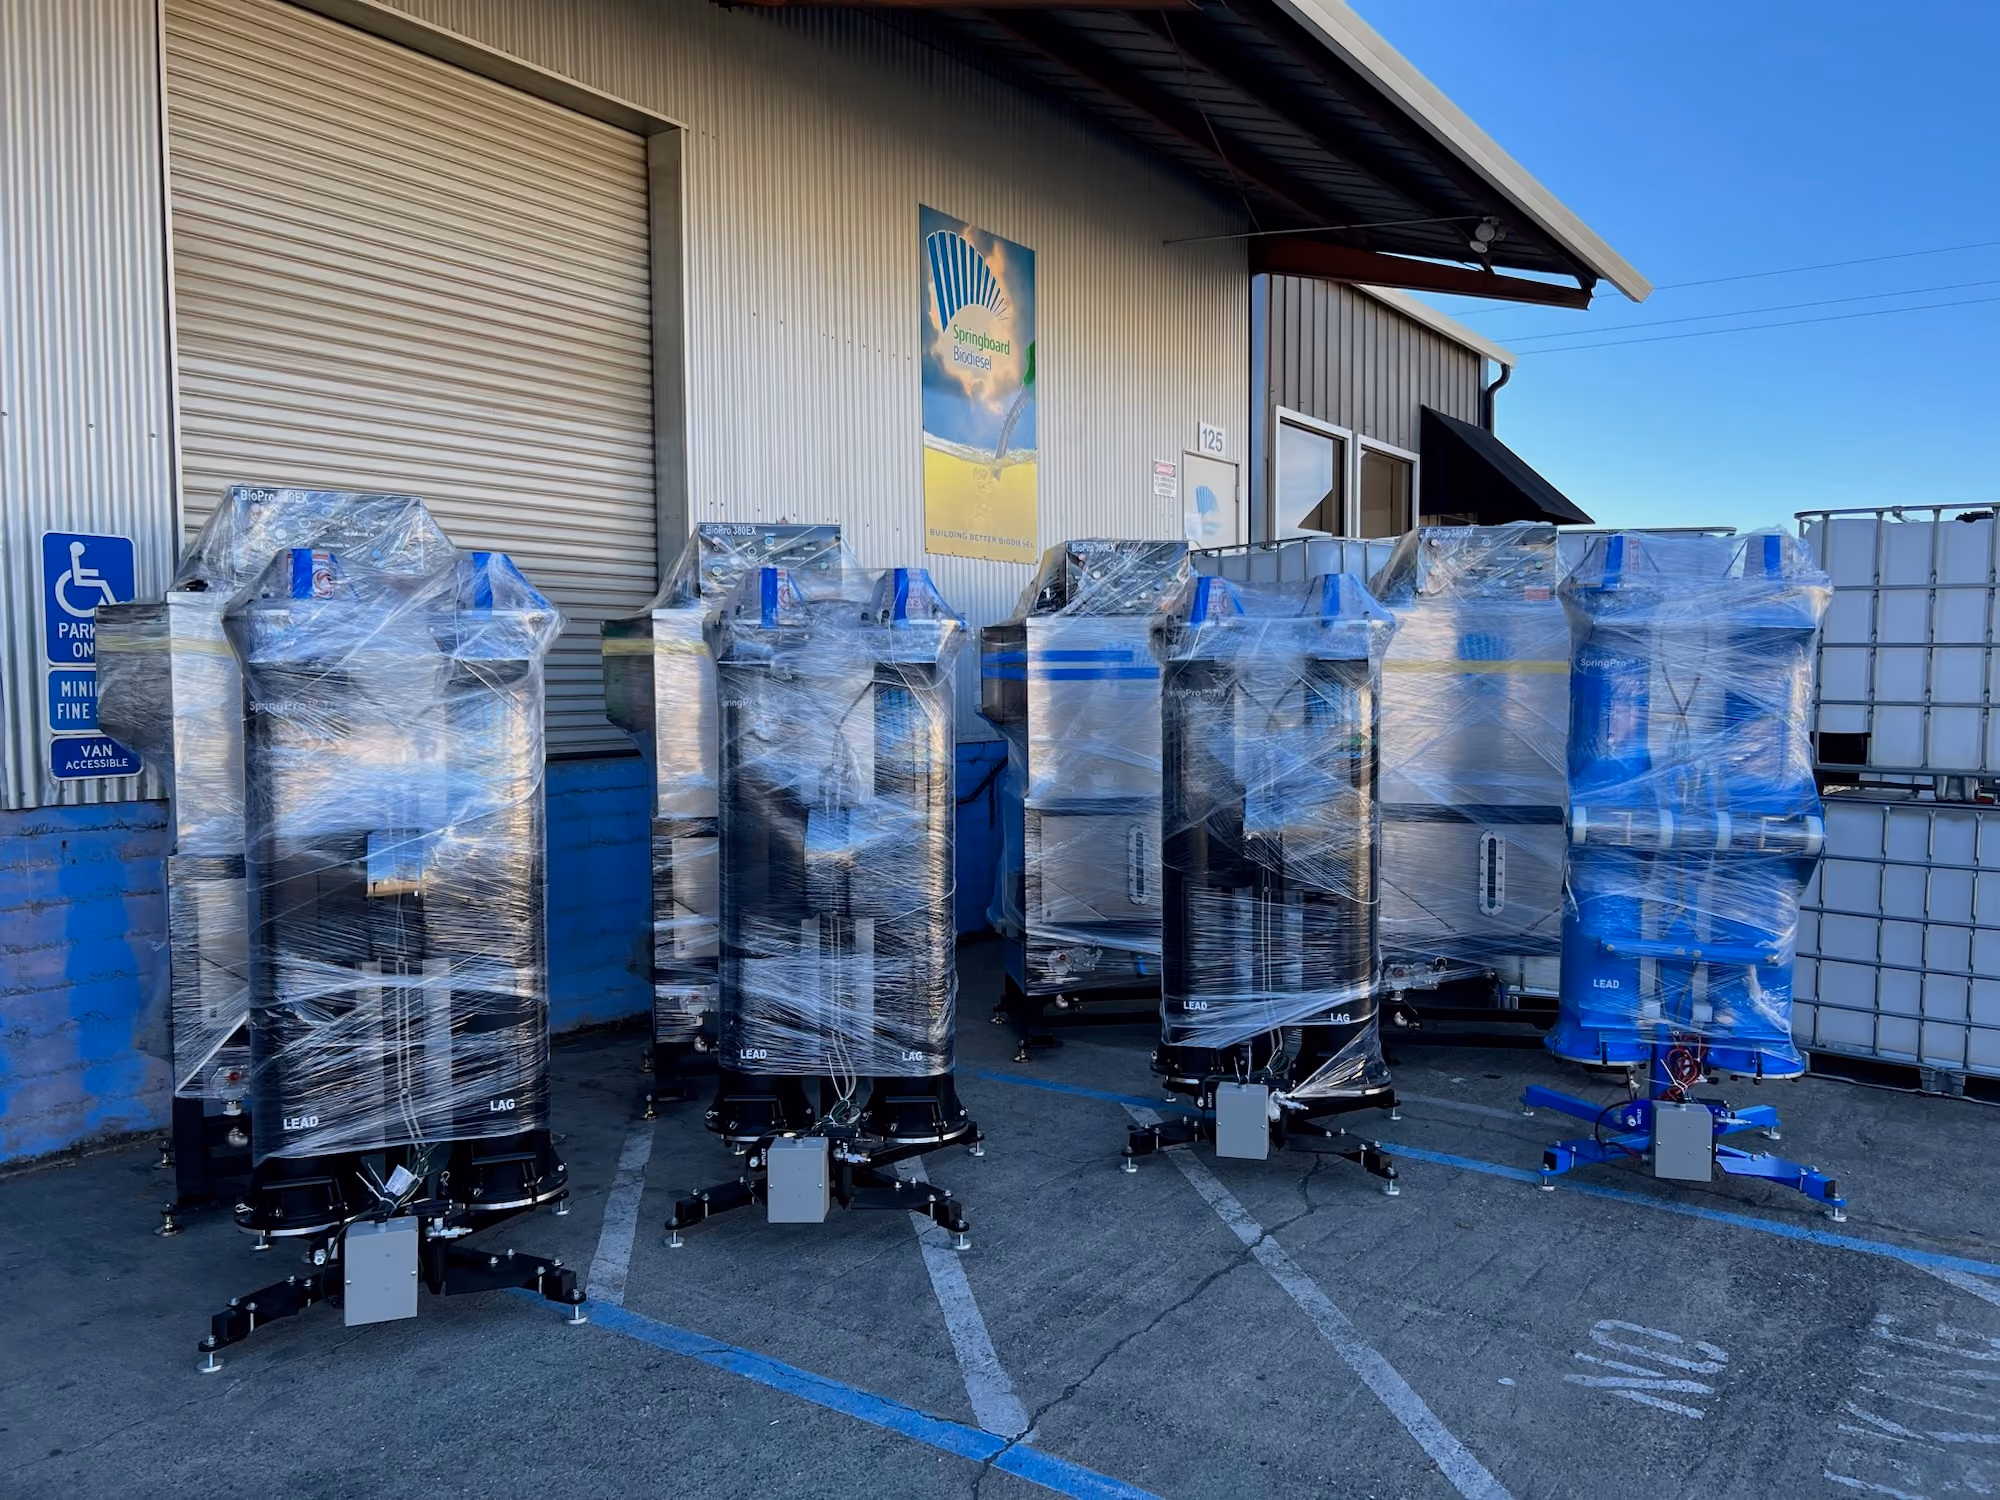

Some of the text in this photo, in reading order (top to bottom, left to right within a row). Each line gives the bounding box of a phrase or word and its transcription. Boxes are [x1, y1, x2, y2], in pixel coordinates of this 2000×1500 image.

[953, 323, 1010, 356] Springboard
[953, 345, 992, 371] Biodiesel
[1202, 427, 1223, 452] 125
[705, 525, 731, 536] BioPro
[929, 528, 1034, 549] BUILDING BETTER BIODIESEL
[58, 622, 96, 639] PARK
[72, 642, 95, 658] ON
[61, 681, 98, 698] MINI
[57, 703, 90, 720] FINE
[81, 744, 112, 758] VAN
[65, 758, 129, 770] ACCESSIBLE
[1593, 978, 1620, 989] LEAD
[1183, 1001, 1208, 1010] LEAD
[1330, 1013, 1351, 1022] LAG
[740, 1049, 767, 1059] LEAD
[902, 1051, 923, 1061] LAG
[490, 1098, 516, 1112] LAG
[283, 1115, 320, 1131] LEAD
[1563, 1318, 1729, 1420] NO
